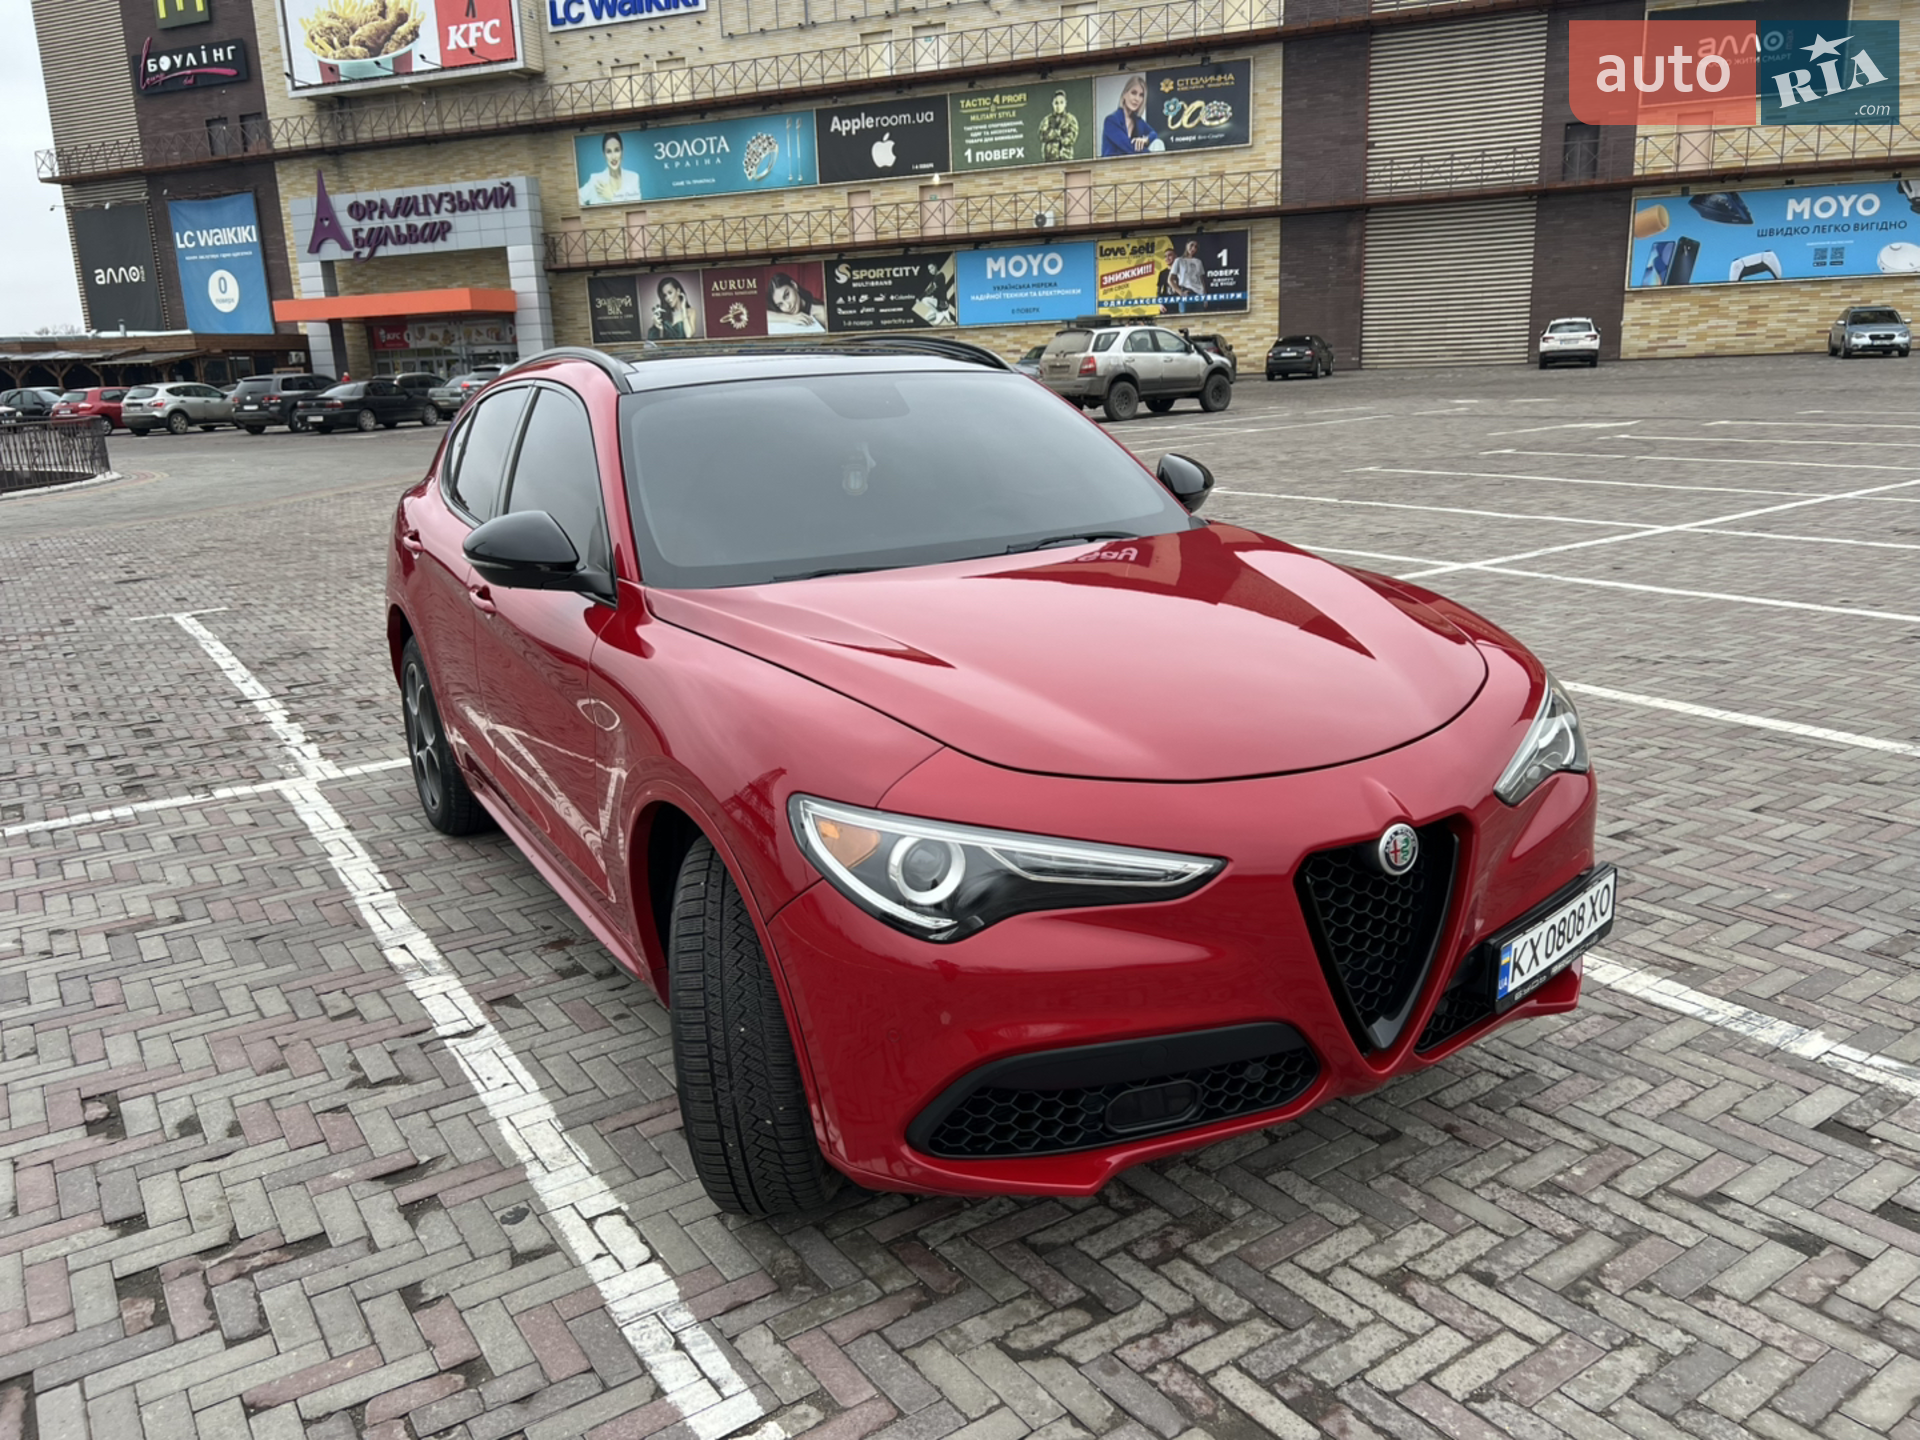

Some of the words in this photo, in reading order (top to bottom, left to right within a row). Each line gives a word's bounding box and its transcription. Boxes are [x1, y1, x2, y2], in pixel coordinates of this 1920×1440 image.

[447, 19, 501, 50] KFC
[960, 97, 991, 109] TACTIC
[993, 94, 1000, 105] 4
[1002, 92, 1027, 104] PROFI
[830, 111, 934, 136] Appleroom.ua
[970, 113, 997, 121] MILITARY
[998, 110, 1016, 119] STYLE
[654, 135, 730, 160] ЗОЛОТА
[964, 148, 972, 163] 1
[975, 147, 1025, 162] ПОВЕРХ
[347, 181, 517, 222] ФРАНЦУЗЬКИЙ
[1786, 193, 1881, 221] MOYO
[1757, 225, 1810, 238] ШВИДКО
[1812, 223, 1851, 234] ЛЕГКО
[1853, 220, 1908, 232] ВИГІДНО
[175, 230, 195, 249] LC
[986, 252, 1063, 279] MOYO
[1217, 248, 1228, 267] 1
[852, 265, 920, 280] SPORTCITY
[1207, 268, 1240, 278] ПОВЕРХ
[218, 276, 228, 295] 0
[711, 278, 757, 292] AURUM
